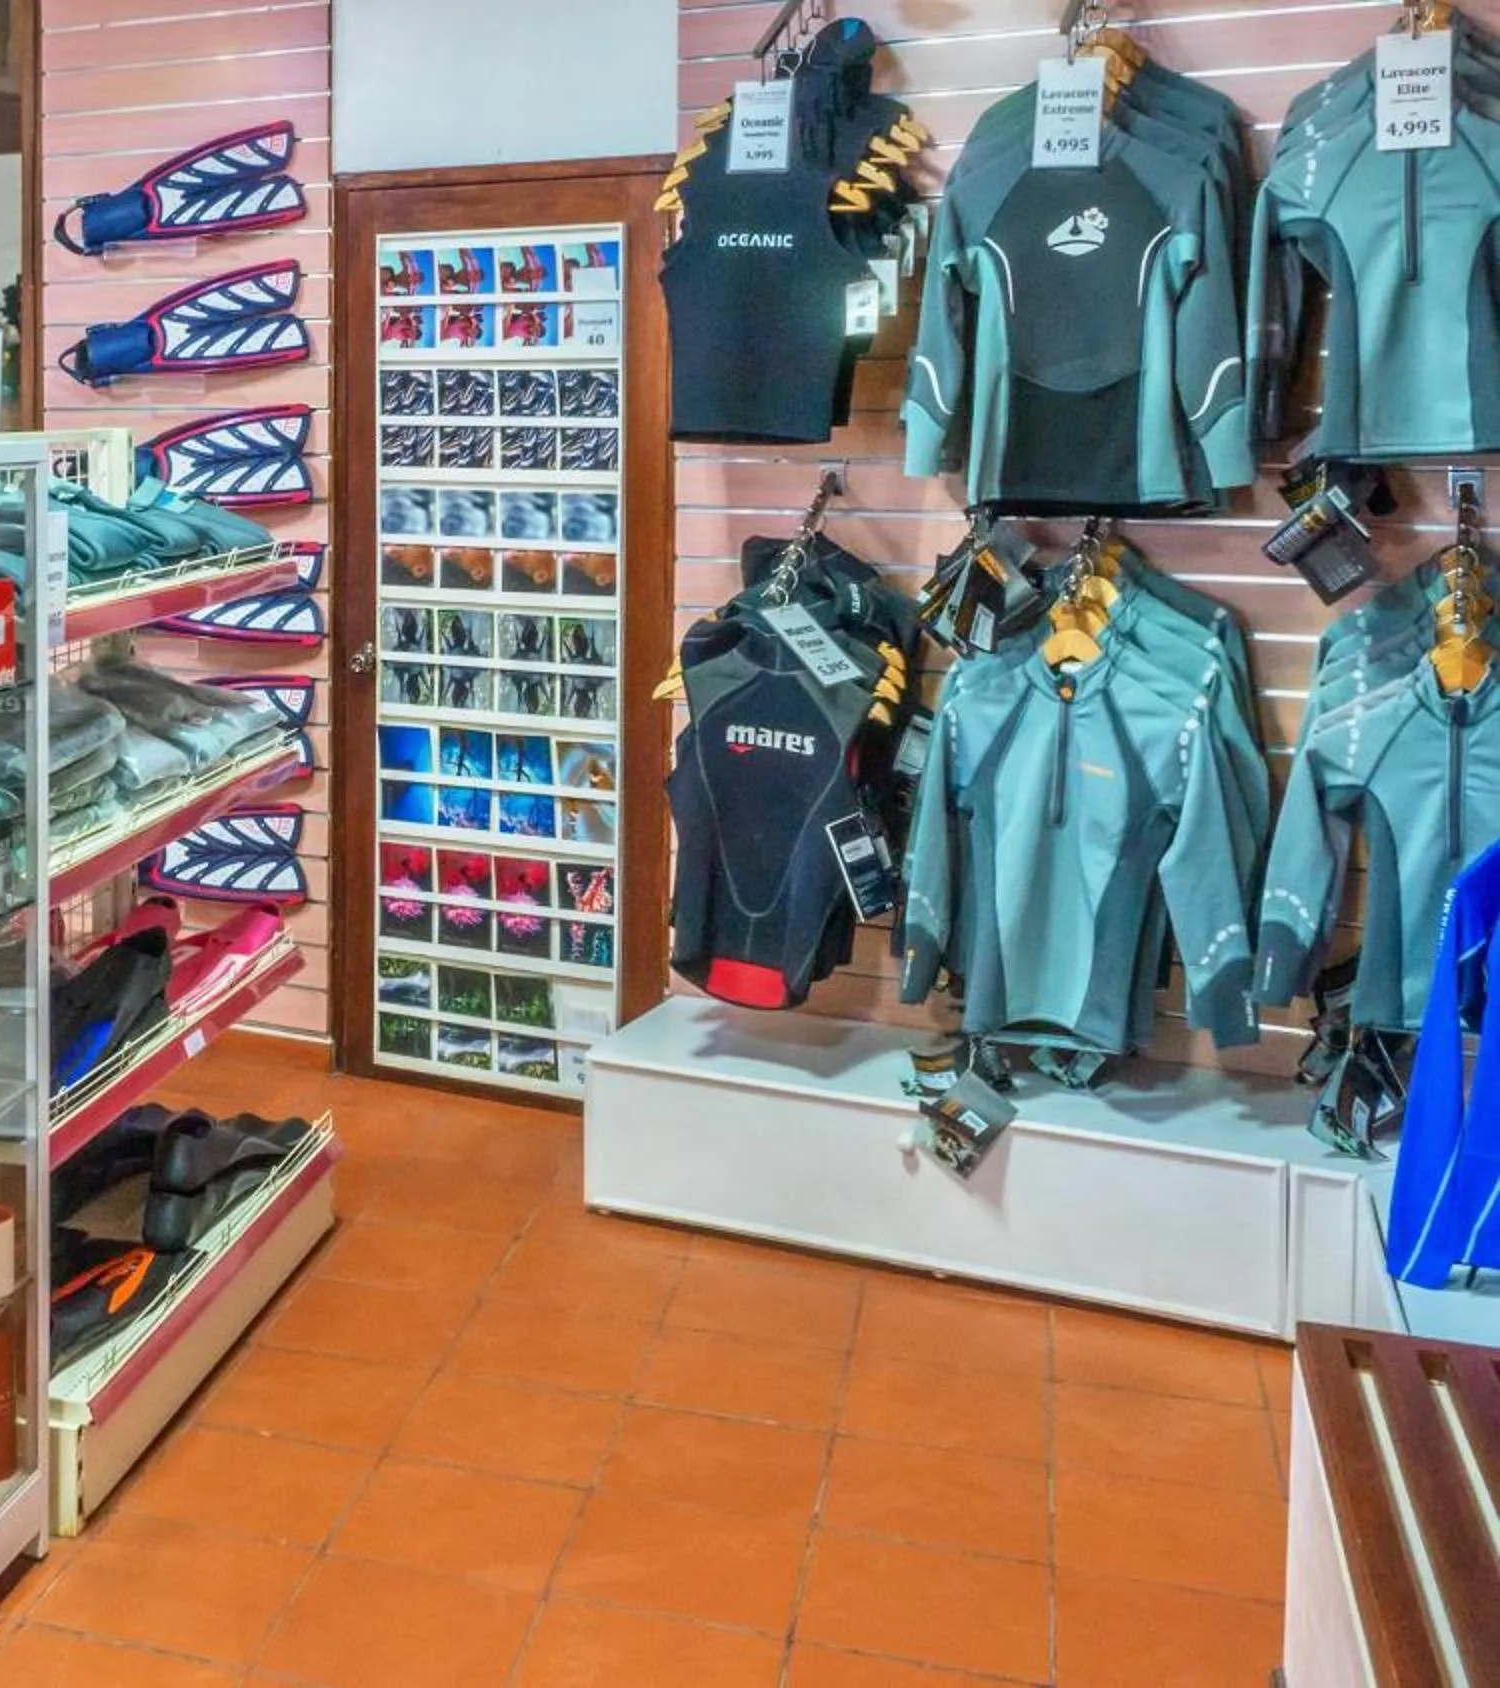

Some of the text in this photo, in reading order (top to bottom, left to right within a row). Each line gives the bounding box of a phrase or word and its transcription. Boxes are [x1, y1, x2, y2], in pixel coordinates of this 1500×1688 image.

[1381, 65, 1447, 79] Lavacore
[1041, 89, 1099, 99] Lavacore
[1397, 83, 1431, 95] Elite
[1386, 119, 1442, 137] 4,995
[1043, 138, 1090, 153] 4,995
[718, 233, 793, 248] OCEANIC
[726, 723, 815, 756] mares
